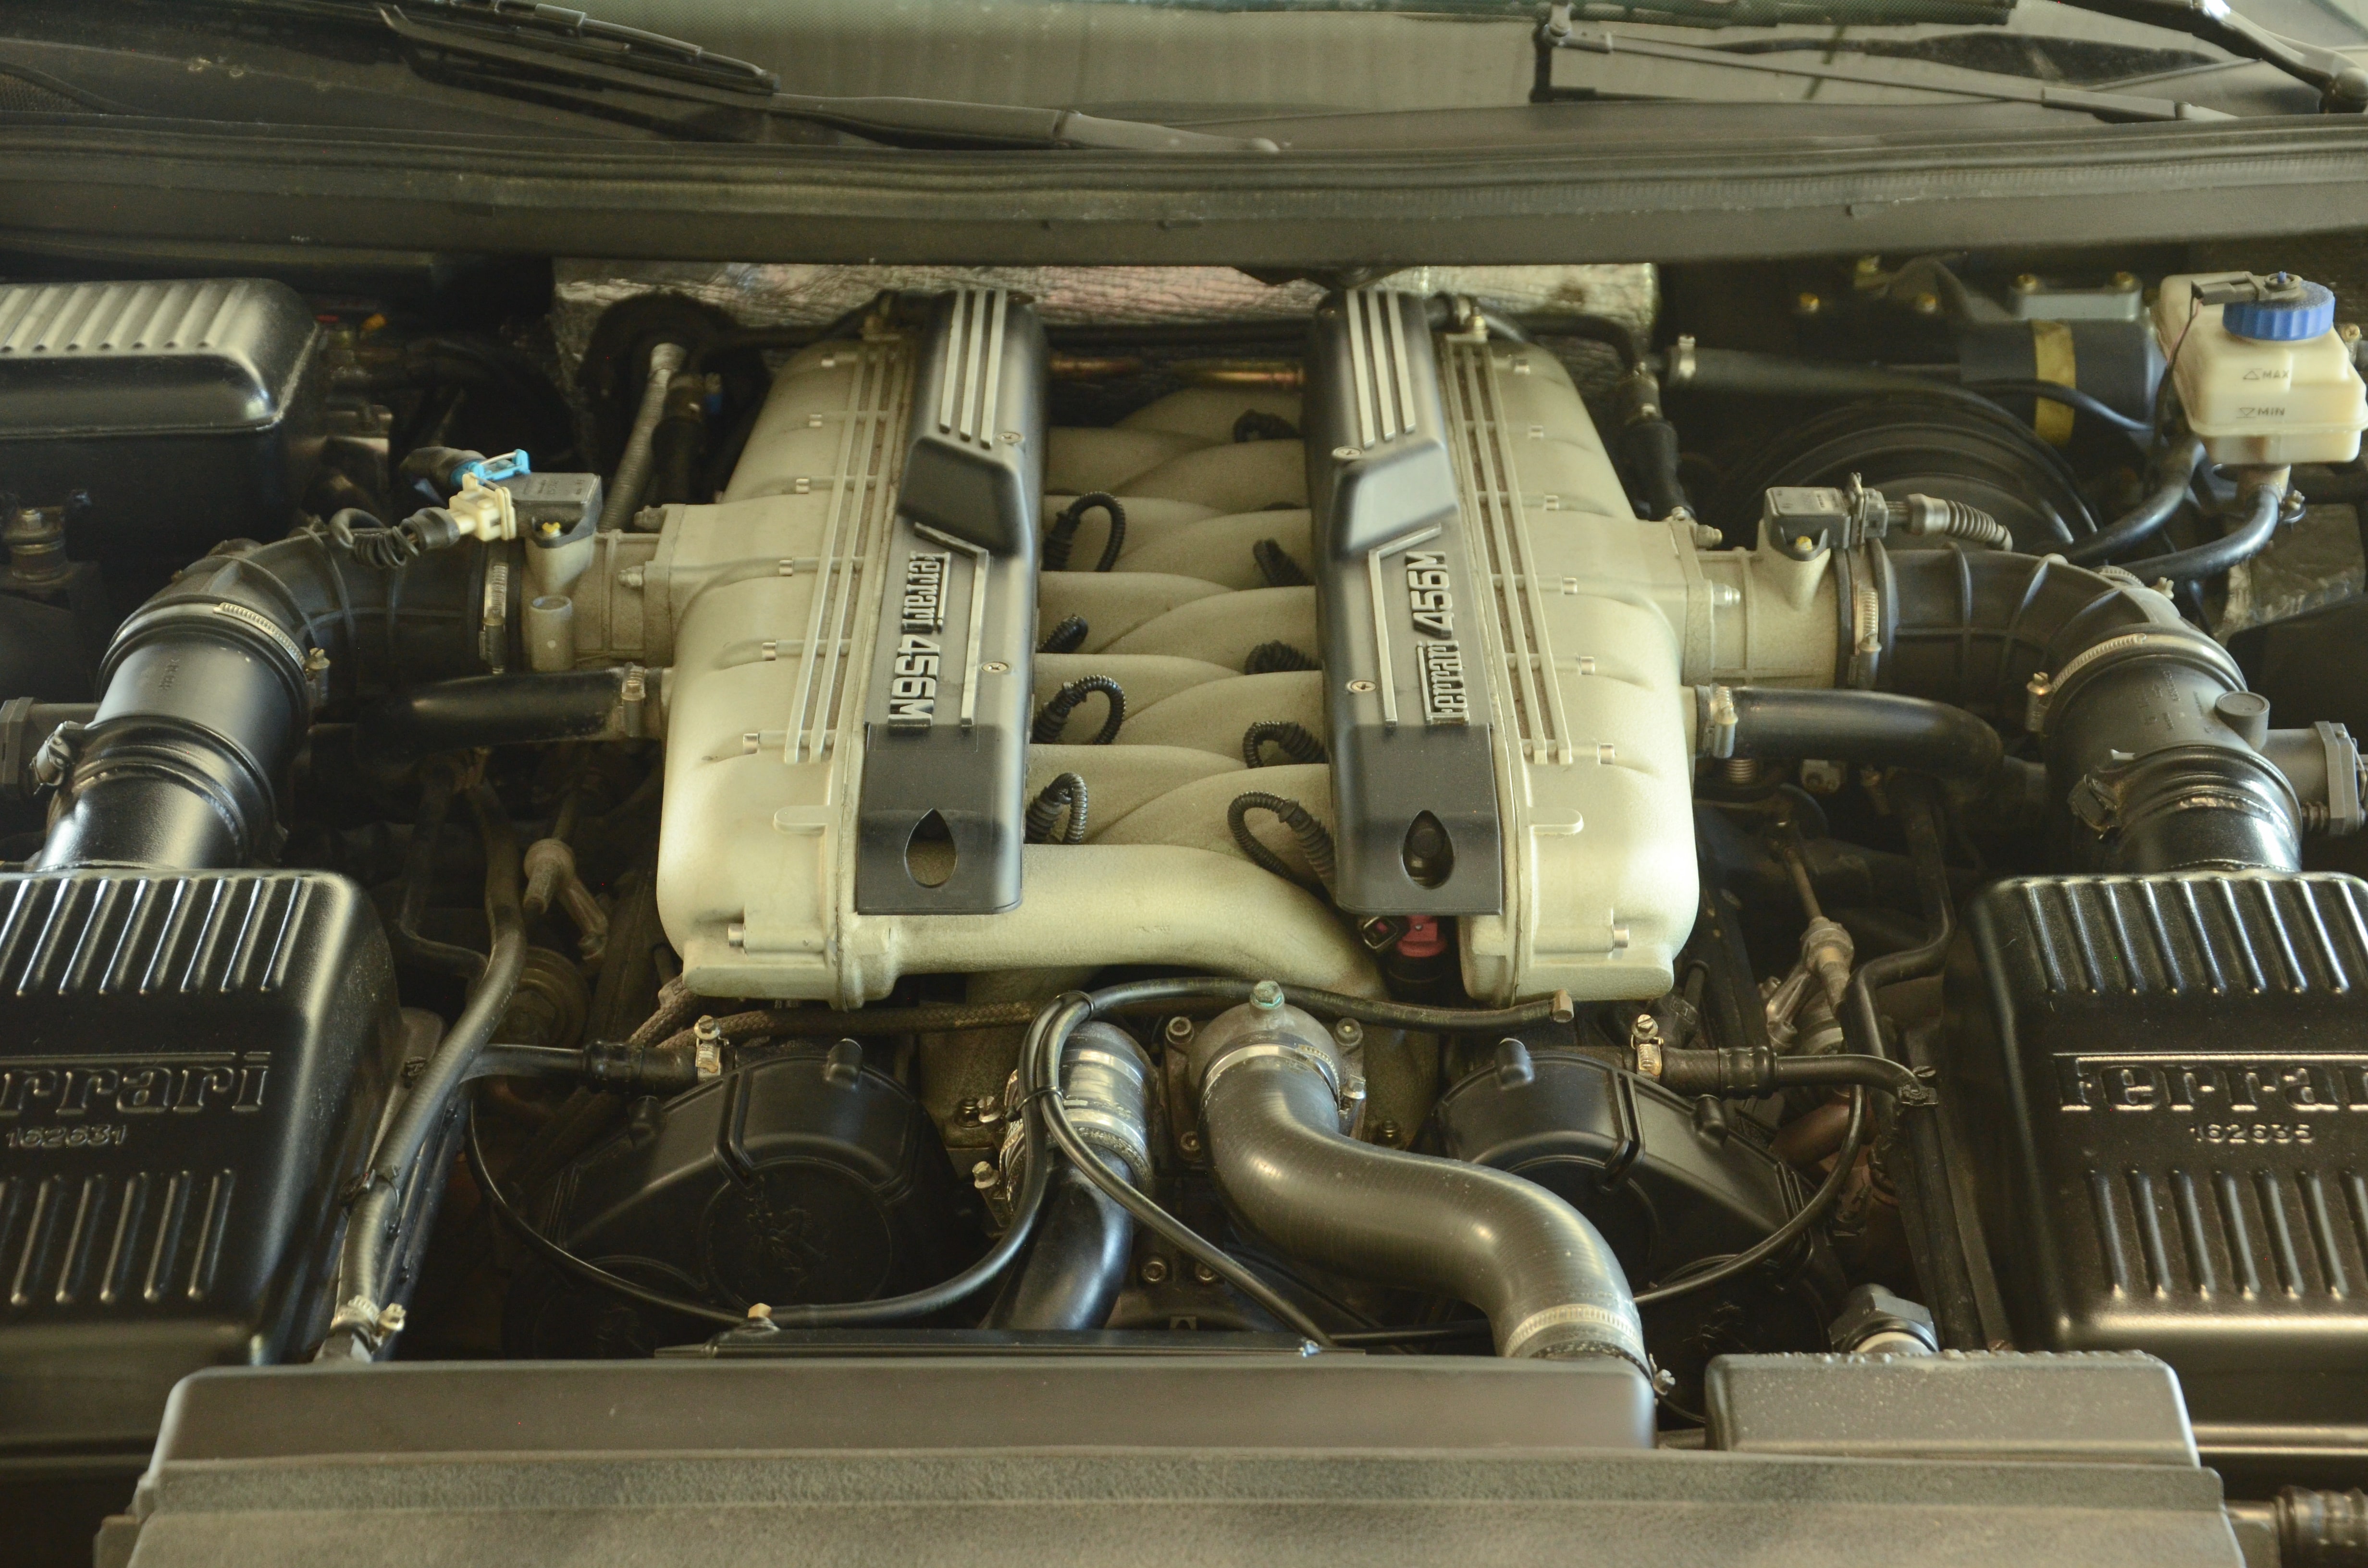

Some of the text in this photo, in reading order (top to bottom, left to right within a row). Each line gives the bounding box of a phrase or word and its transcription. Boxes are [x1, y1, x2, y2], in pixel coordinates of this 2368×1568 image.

[2262, 370, 2289, 379] MAX
[2257, 407, 2285, 416] MIN
[901, 550, 951, 635] Ferrari
[1416, 639, 1470, 725] Ferrari
[6, 1124, 128, 1148] 162631
